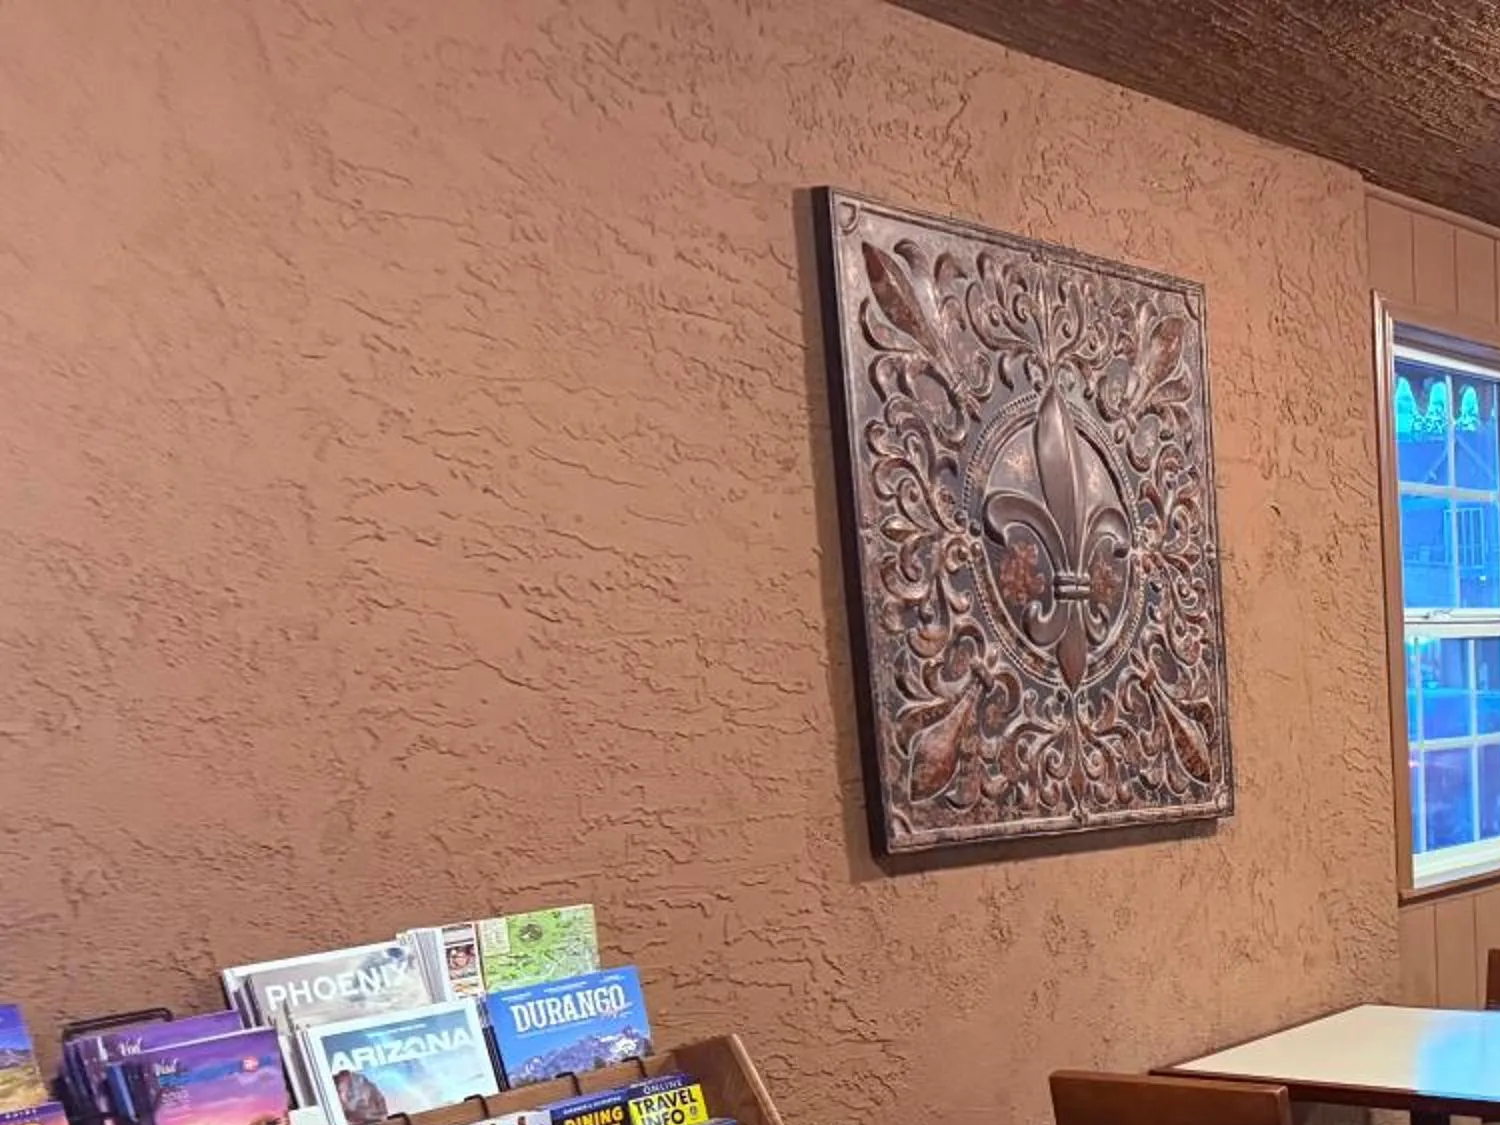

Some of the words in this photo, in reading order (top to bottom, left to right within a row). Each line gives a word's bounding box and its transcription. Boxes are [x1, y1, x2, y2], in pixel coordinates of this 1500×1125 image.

[264, 961, 411, 1012] PHOENIX
[510, 984, 625, 1033] DURANGO
[330, 1026, 474, 1074] ARIZONA
[635, 1088, 697, 1116] TRAVEL
